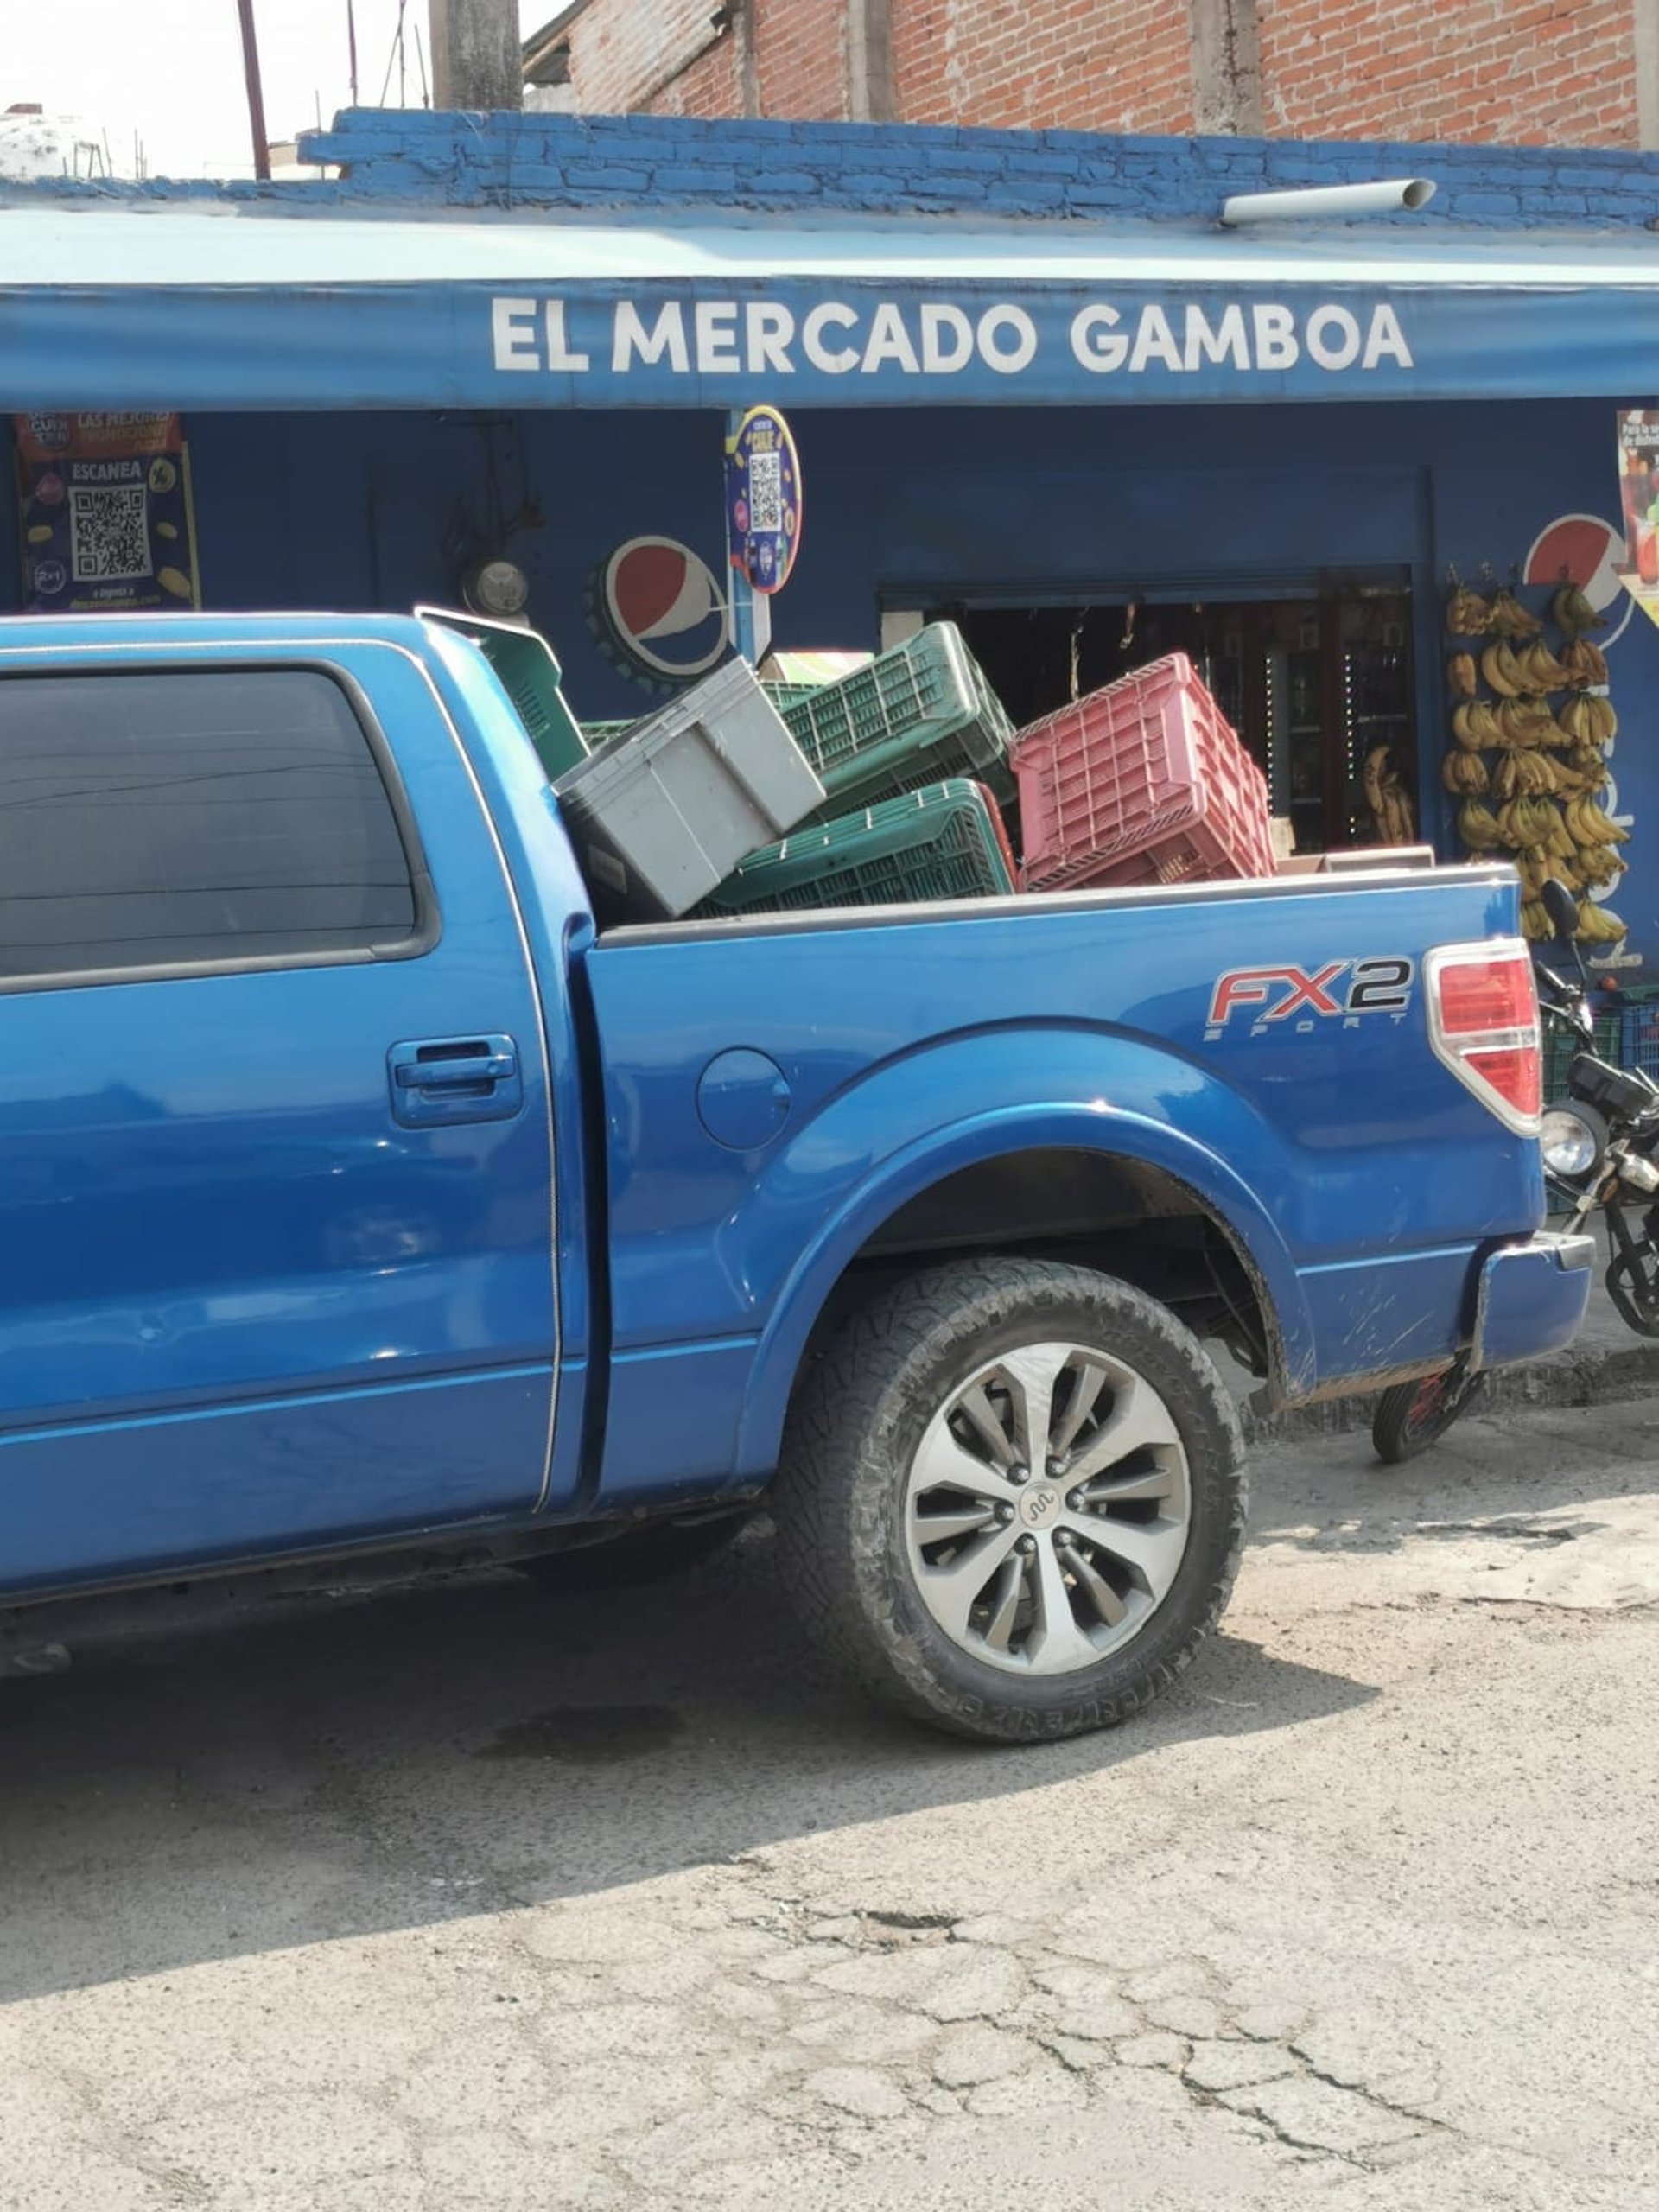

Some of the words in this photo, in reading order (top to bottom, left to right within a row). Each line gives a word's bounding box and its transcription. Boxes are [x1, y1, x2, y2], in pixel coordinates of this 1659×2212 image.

[492, 297, 590, 372] EL
[611, 301, 1038, 374] MERCADO
[1070, 302, 1414, 373] GAMBOA
[72, 460, 142, 481] ESCANEA
[1205, 954, 1414, 1028] FX2
[1203, 1011, 1408, 1042] SPORT
